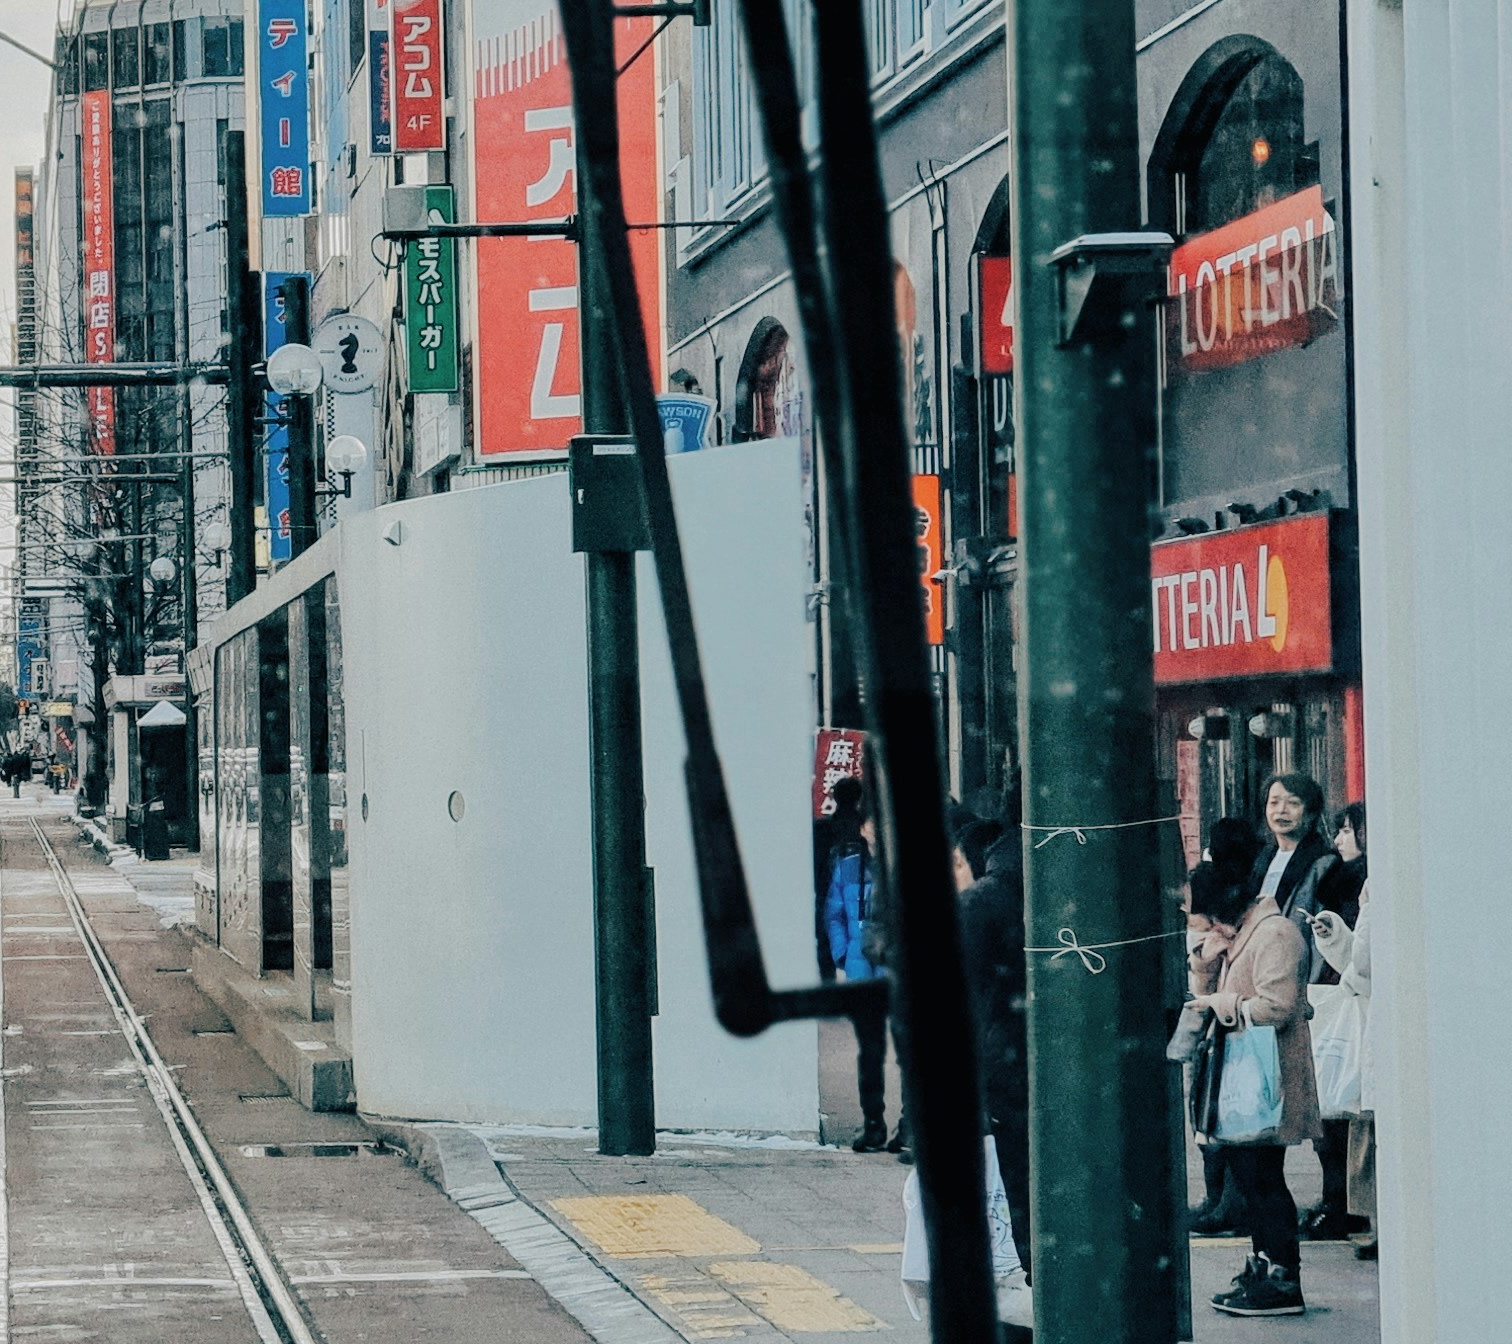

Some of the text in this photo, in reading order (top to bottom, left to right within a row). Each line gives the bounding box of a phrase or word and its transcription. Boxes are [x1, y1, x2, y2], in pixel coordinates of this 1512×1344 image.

[402, 15, 434, 99] アコム
[406, 114, 432, 132] 4F
[417, 237, 443, 371] モスバーガー
[1178, 208, 1341, 357] LOTTERIA
[89, 270, 110, 440] 閉店SLE
